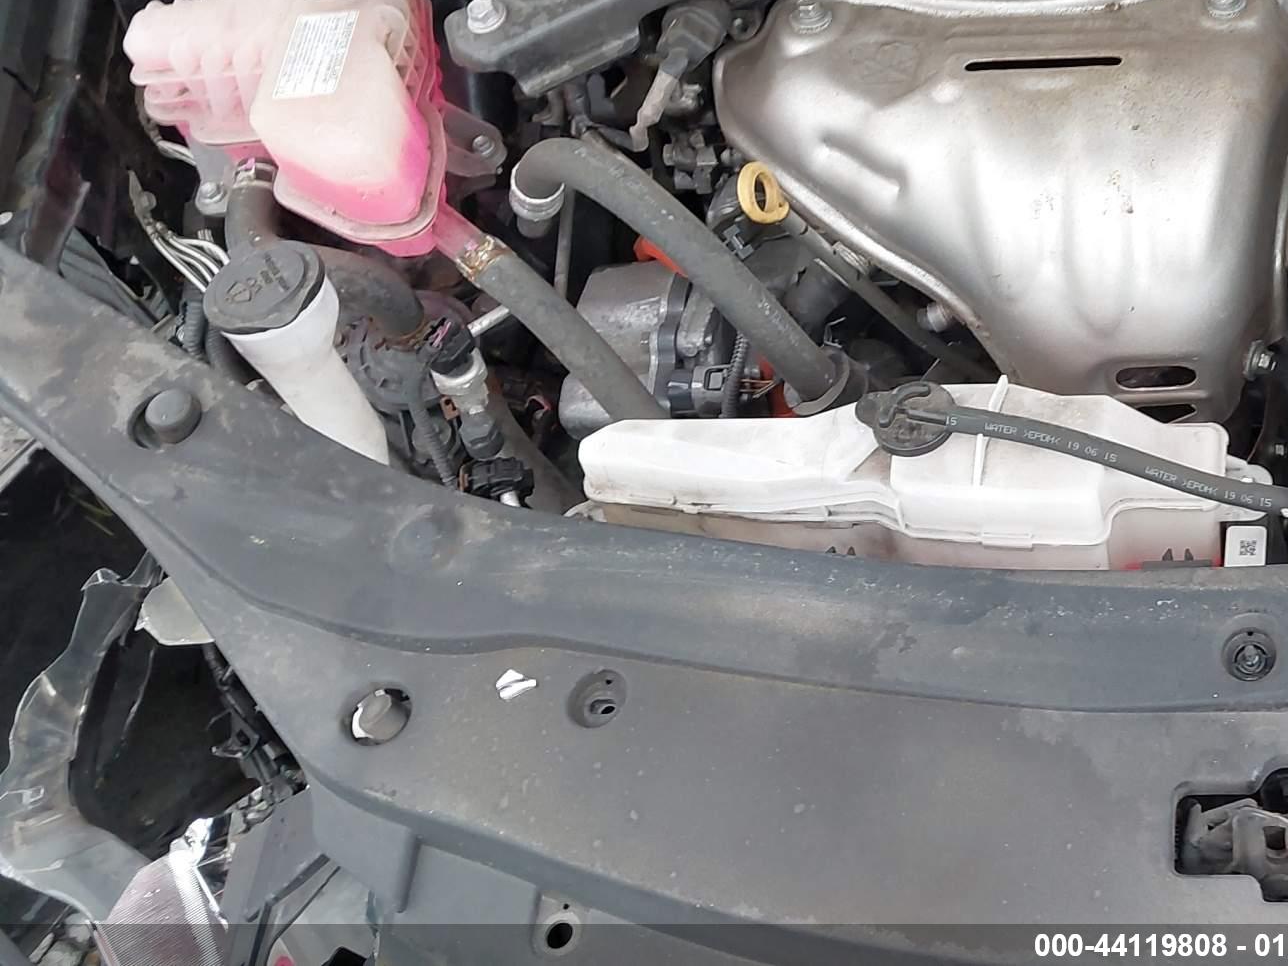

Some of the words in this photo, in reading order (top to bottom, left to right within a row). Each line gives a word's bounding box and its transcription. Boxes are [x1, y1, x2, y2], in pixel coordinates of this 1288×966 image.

[984, 422, 1017, 435] WATER
[1067, 441, 1080, 451] 19
[1084, 446, 1099, 457] 06
[1104, 451, 1119, 463] 15
[1144, 465, 1178, 484] WATER
[1223, 490, 1236, 500] 19
[1258, 497, 1273, 508] 15
